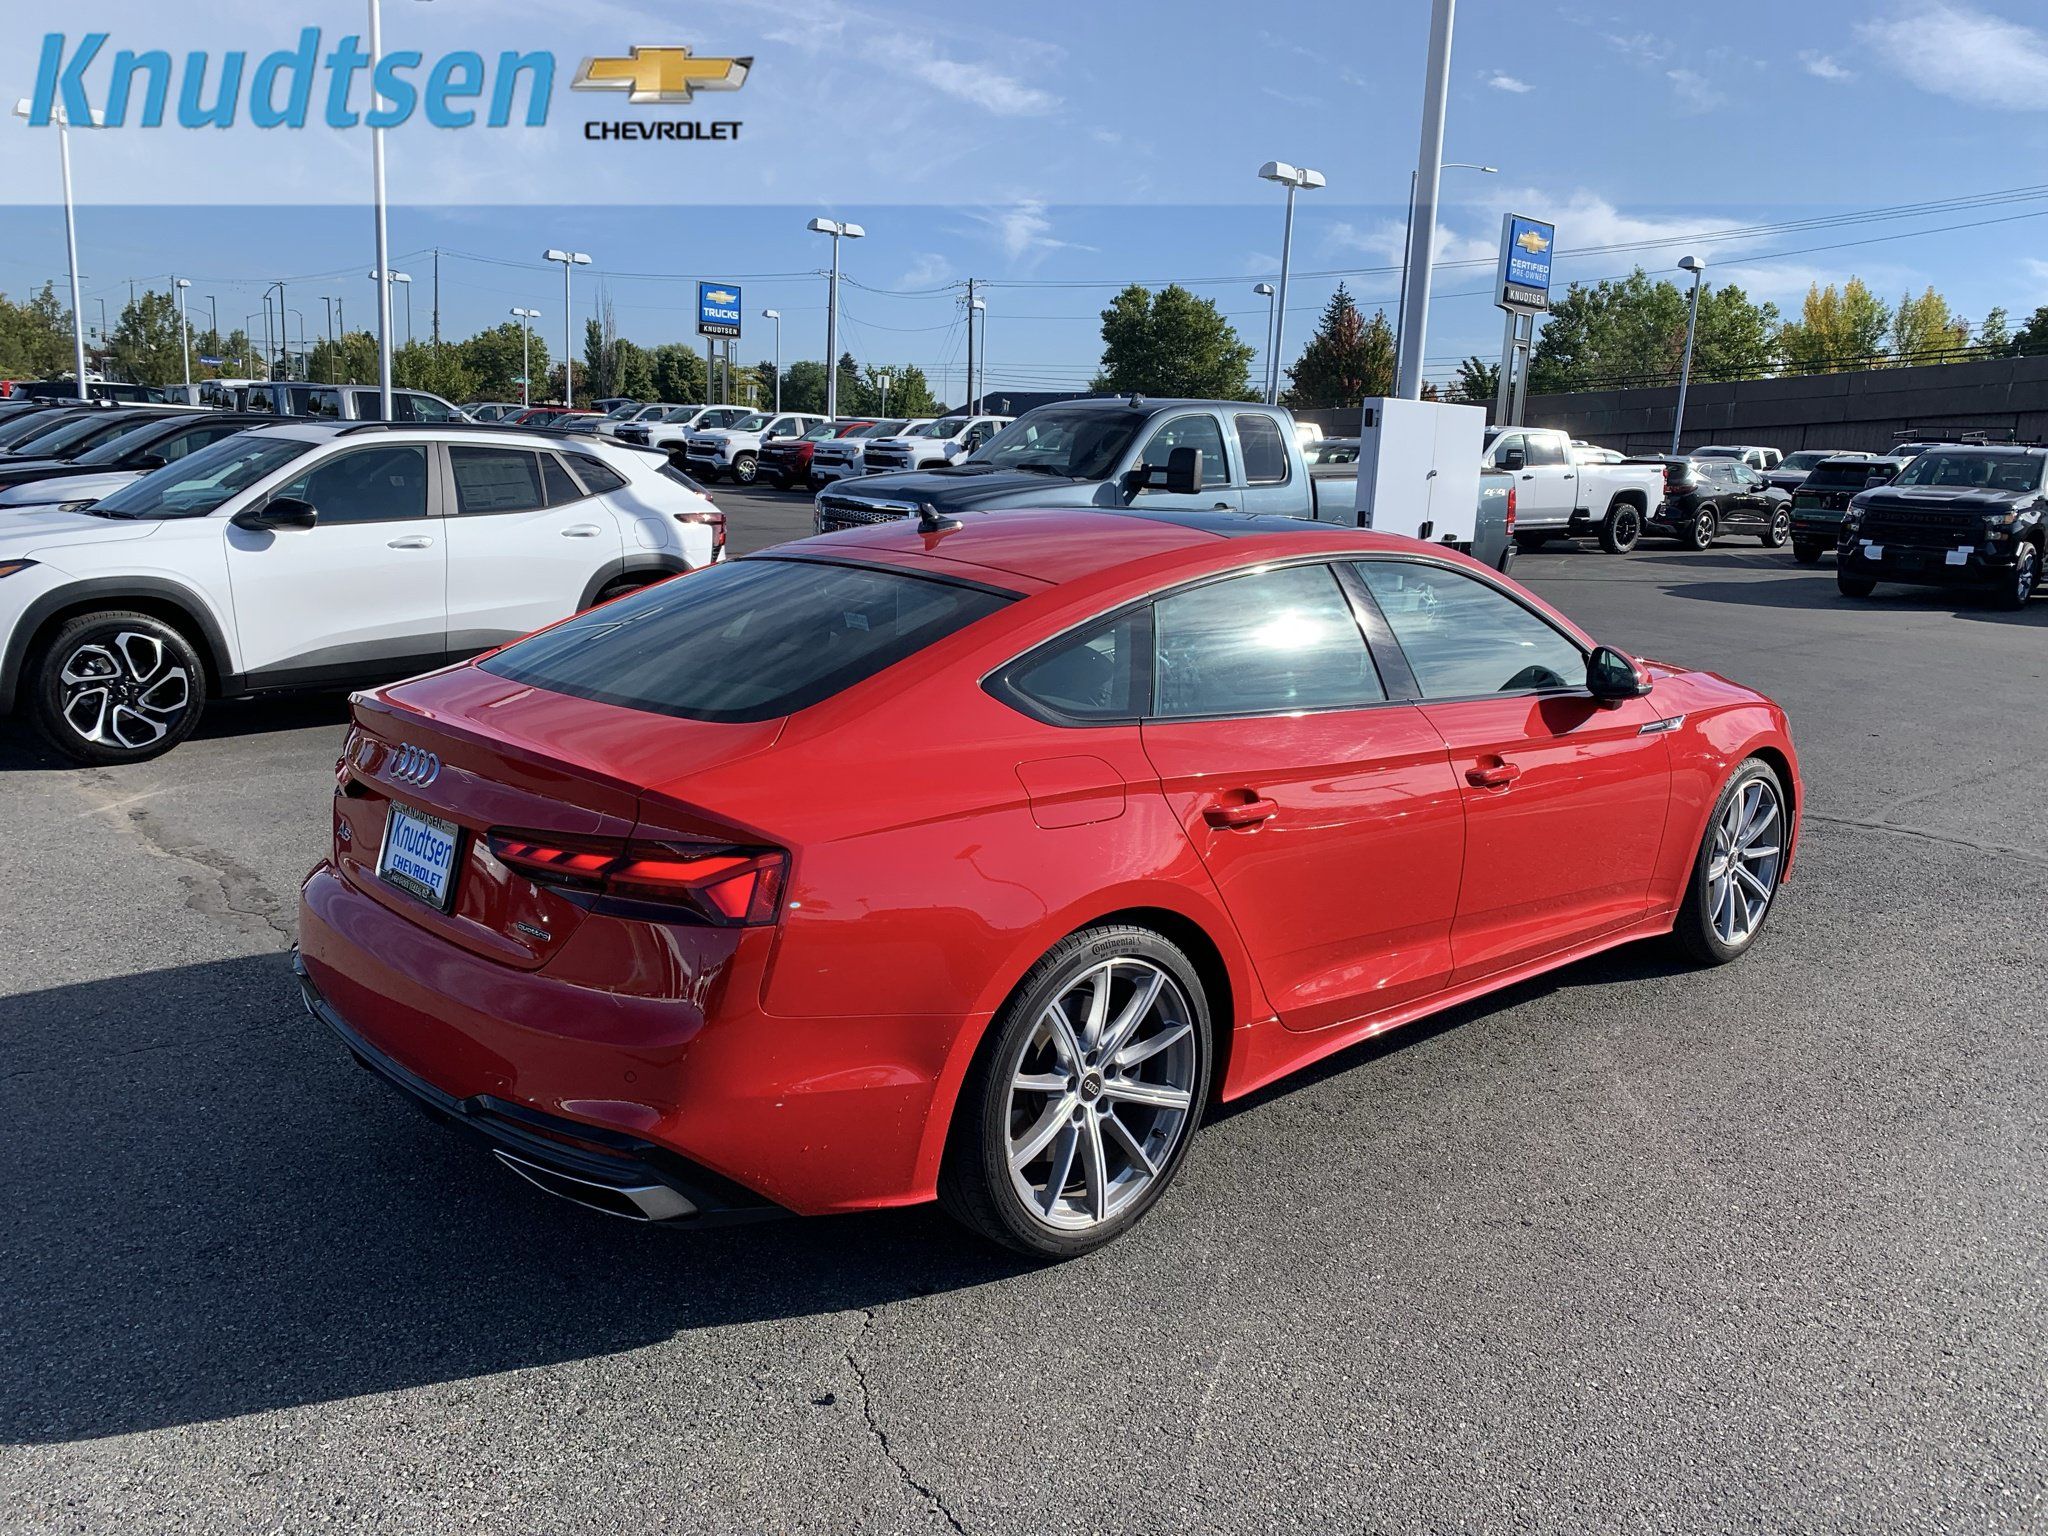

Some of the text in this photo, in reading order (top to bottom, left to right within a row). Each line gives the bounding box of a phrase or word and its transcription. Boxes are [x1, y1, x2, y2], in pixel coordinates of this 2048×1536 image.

[1511, 258, 1549, 274] CERTIFIED
[1512, 267, 1547, 282] PRE-OWNED
[1510, 289, 1545, 305] KNUDTSEN
[703, 307, 739, 320] TRUCKS
[703, 325, 738, 335] KNUDTSEN
[393, 814, 453, 870] Knudtsen
[392, 853, 443, 889] CHEVROLET
